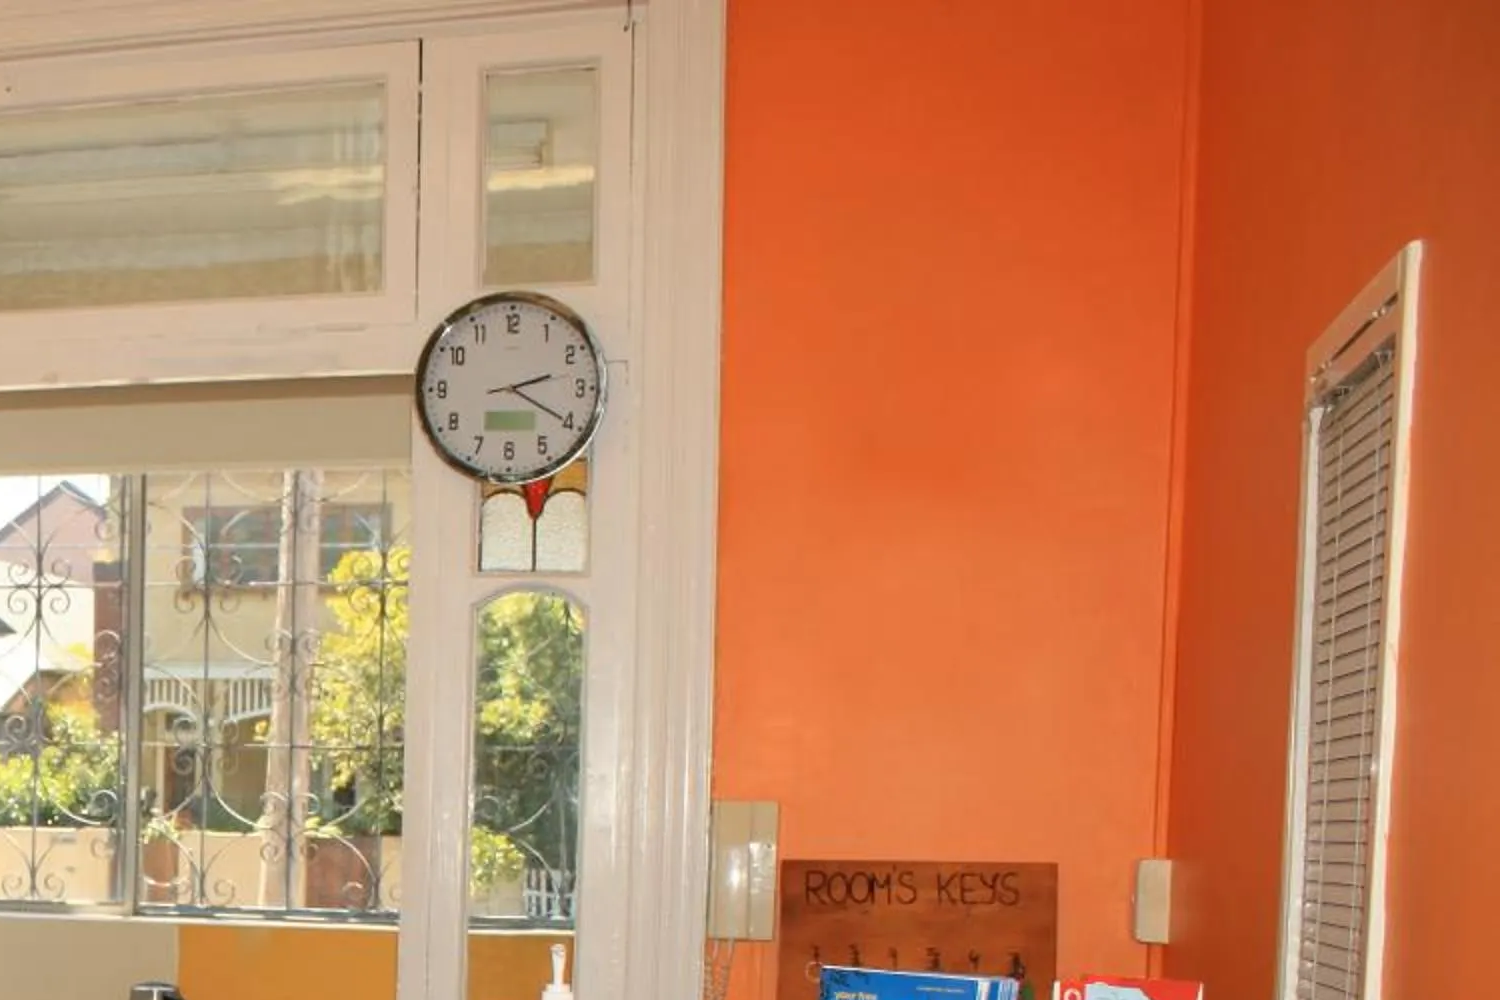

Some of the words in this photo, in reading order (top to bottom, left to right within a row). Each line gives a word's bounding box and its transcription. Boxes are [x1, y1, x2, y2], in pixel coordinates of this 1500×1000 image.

[505, 313, 520, 334] 12
[543, 323, 549, 343] 1
[474, 323, 486, 345] 11
[450, 346, 465, 366] 10
[565, 345, 575, 365] 2
[436, 380, 447, 399] 9
[575, 378, 585, 398] 3
[448, 412, 459, 431] 8
[562, 411, 574, 431] 4
[474, 436, 484, 455] 7
[503, 441, 515, 460] 6
[537, 436, 548, 455] 5
[804, 864, 917, 905] ROOM'S
[936, 871, 1020, 906] KEYS
